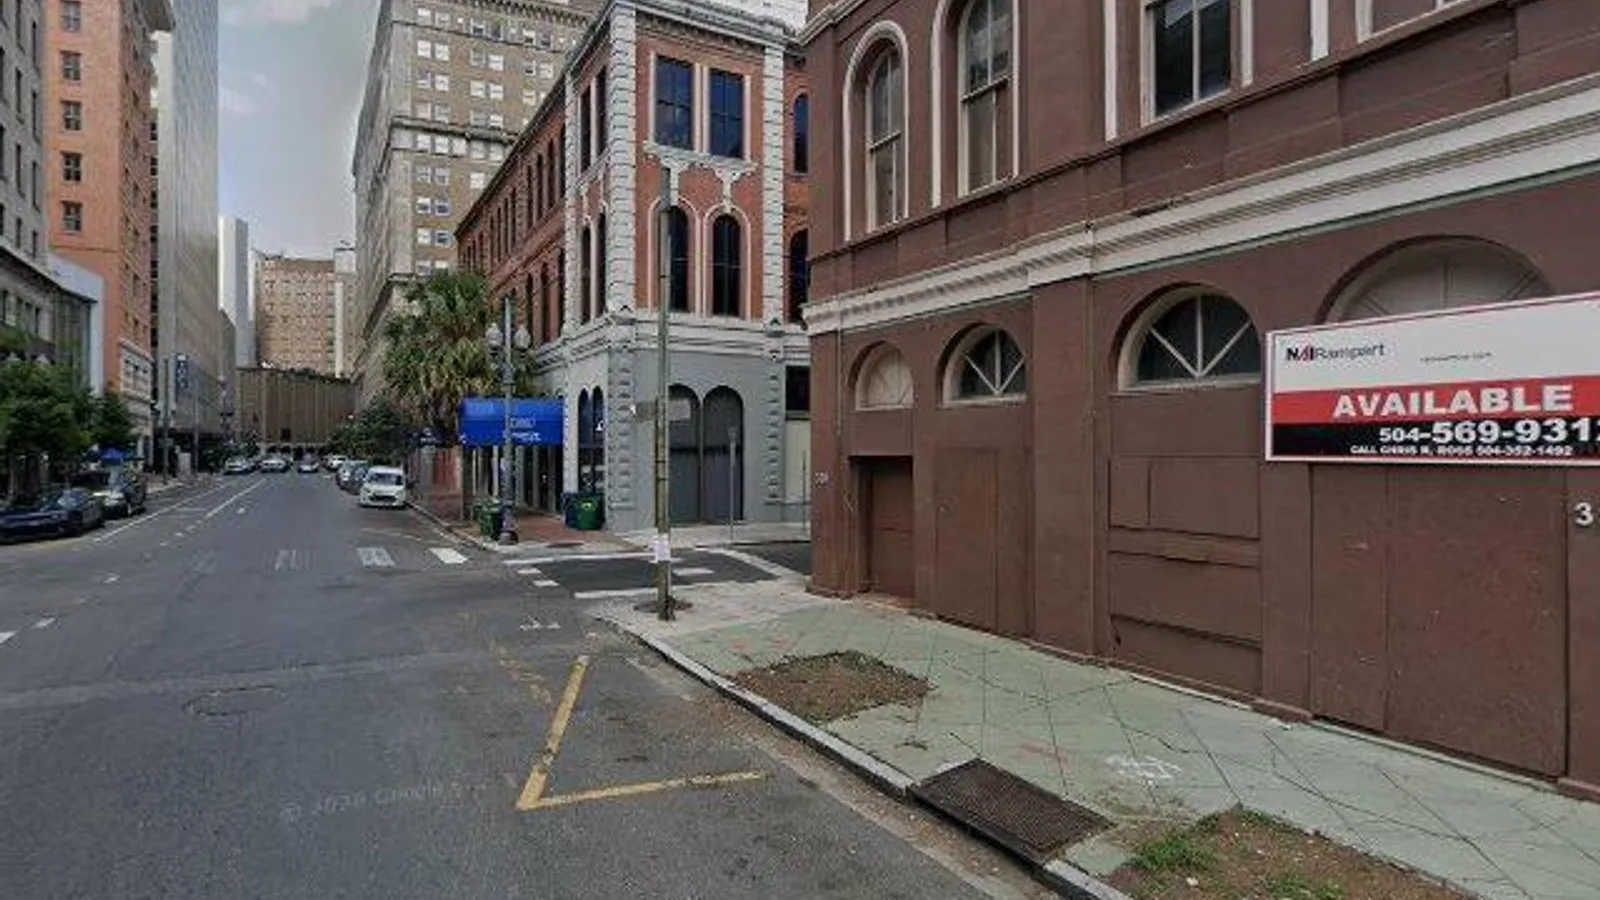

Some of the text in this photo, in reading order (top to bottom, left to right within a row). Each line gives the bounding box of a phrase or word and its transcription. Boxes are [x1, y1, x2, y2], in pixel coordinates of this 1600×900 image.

[1332, 384, 1574, 418] AVAILABLE
[1379, 417, 1600, 443] 504-569-931
[1350, 444, 1378, 455] CALL
[1574, 502, 1594, 526] 3
